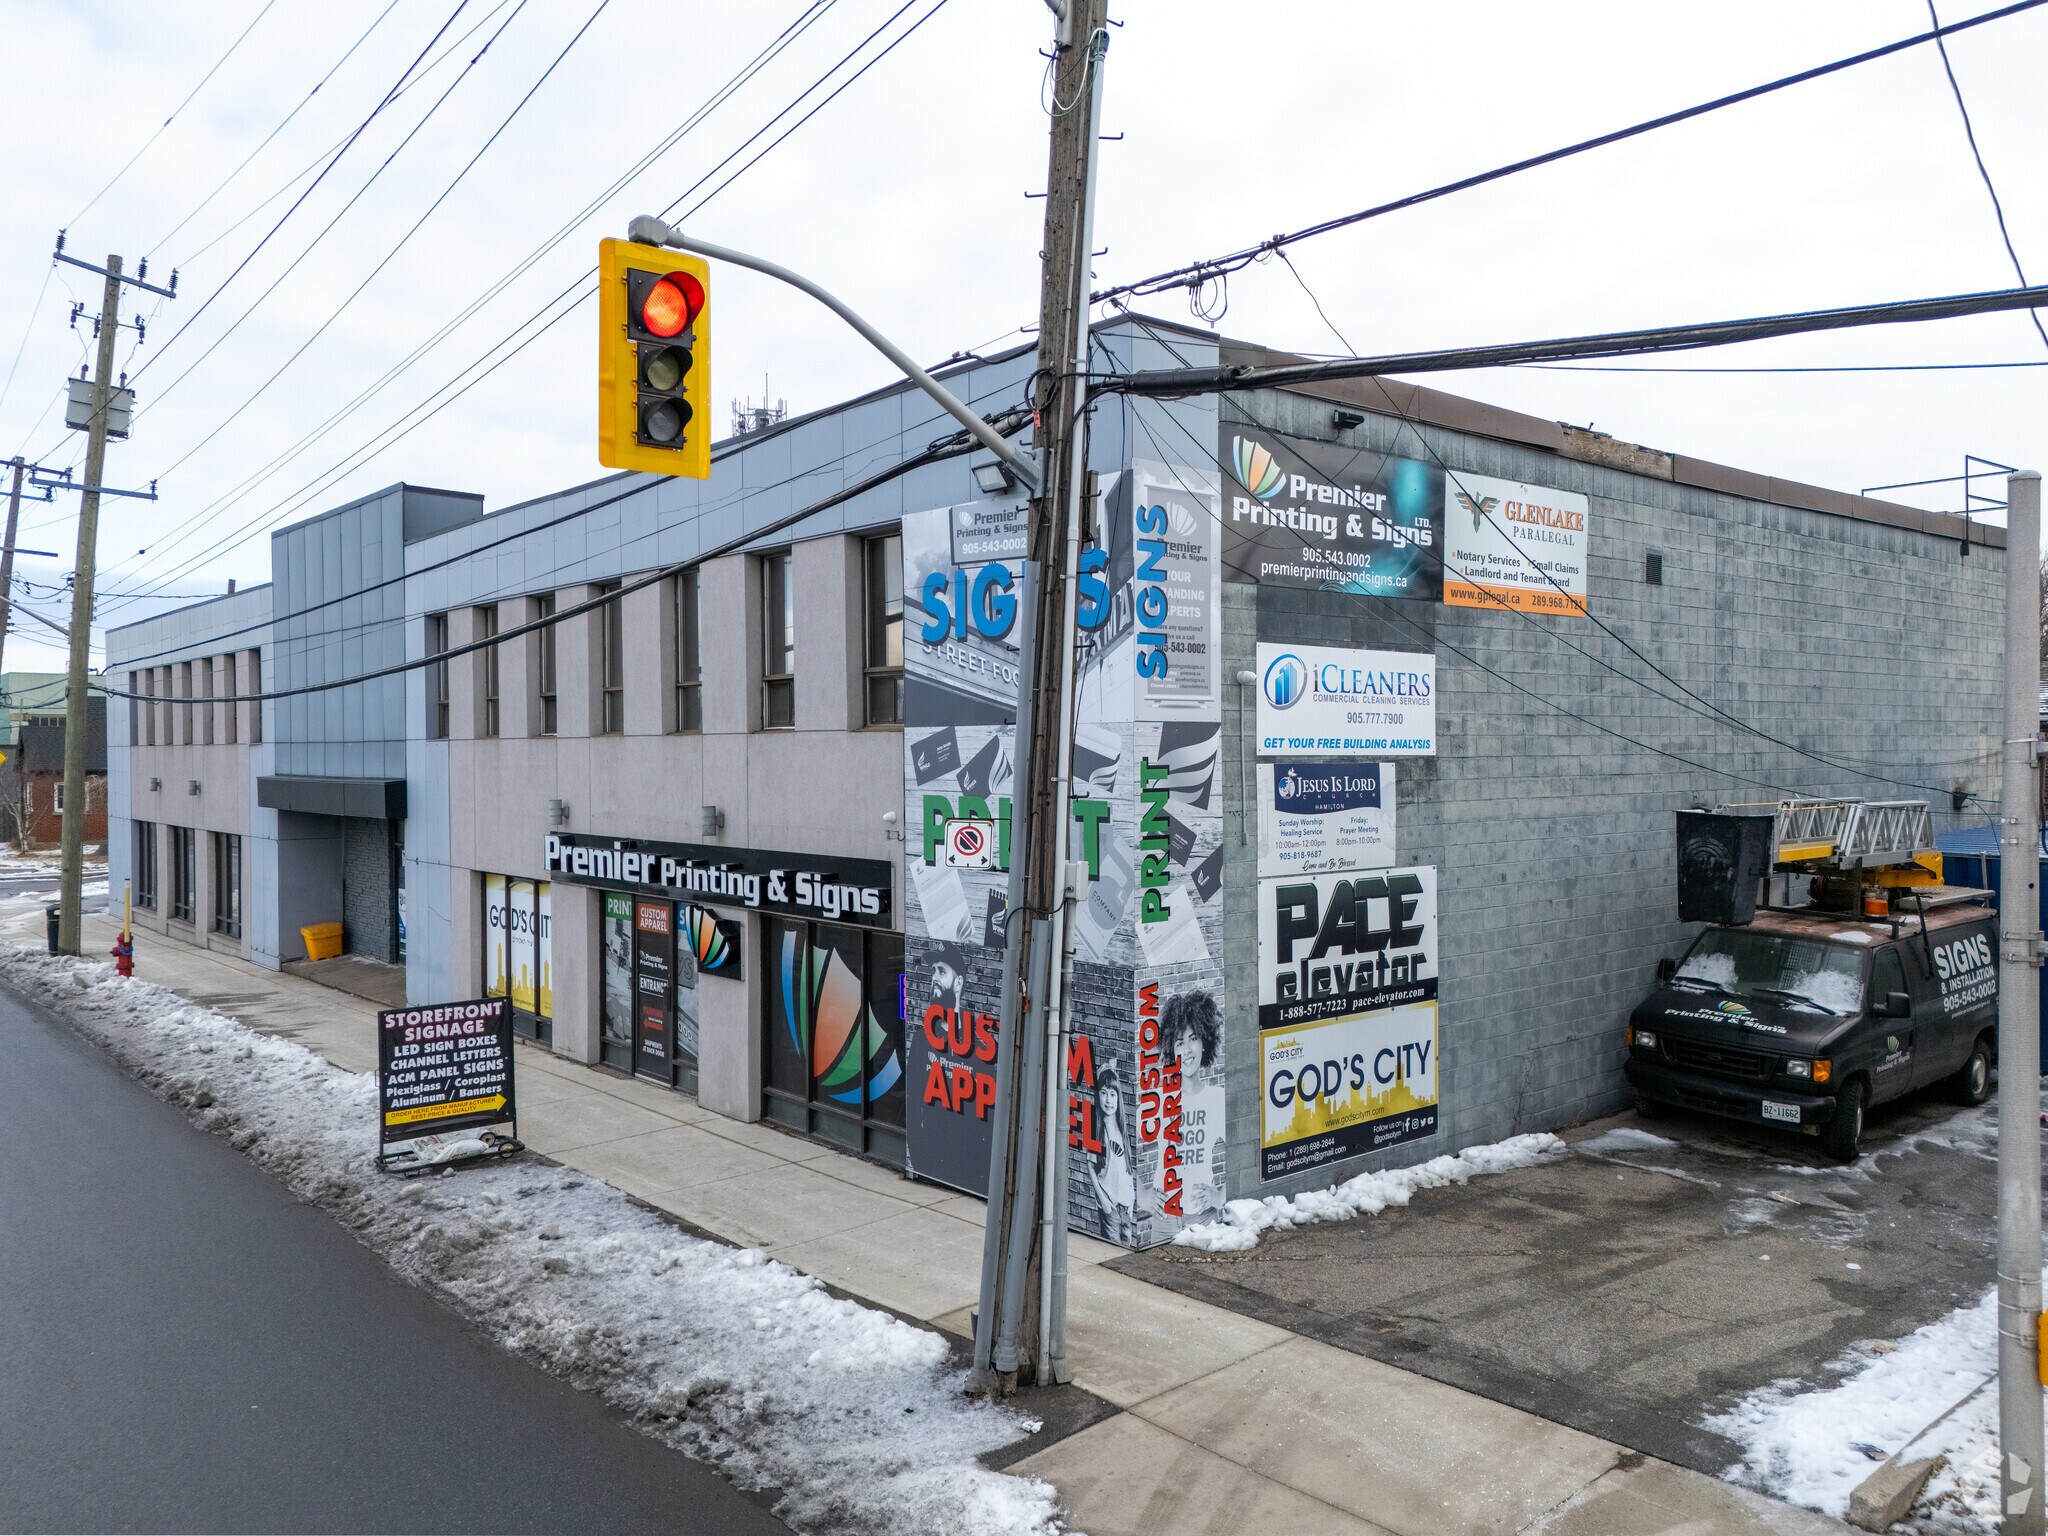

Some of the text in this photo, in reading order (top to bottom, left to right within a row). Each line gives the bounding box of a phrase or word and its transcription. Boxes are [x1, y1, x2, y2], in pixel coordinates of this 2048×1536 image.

[1290, 474, 1386, 511] Premier
[974, 510, 1020, 526] Premier
[1232, 496, 1432, 548] Printing & Signs
[1415, 517, 1432, 528] LTD.
[1504, 500, 1584, 531] GLENLAKE
[956, 521, 1028, 538] Printing & Signs
[1513, 526, 1574, 546] PARALEGAL
[1189, 553, 1208, 562] Signs
[1302, 547, 1371, 568] 905.543.0002
[1456, 550, 1520, 567] Notary Services
[1532, 560, 1579, 574] Small Claims
[1261, 561, 1408, 588] premierprintingandsigns.ca
[1464, 566, 1570, 588] Landlord and Tenant Board
[922, 548, 1112, 645] SIGS
[1136, 505, 1168, 681] SIGNS
[1450, 588, 1520, 605] www.gplegal.ca
[1312, 664, 1430, 697] iCLEANERS
[1312, 694, 1430, 706] COMMERCIAL CLEANING SERVICES
[1346, 712, 1404, 725] 905.777.7900
[1264, 738, 1431, 749] GET YOUR FREE BUILDING ANALYSIS
[1296, 776, 1376, 797] JESUS IS LORD
[1279, 818, 1324, 828] Sunday Worship:
[1340, 826, 1378, 836] Prayer Meeting
[1350, 816, 1368, 824] Friday:
[1140, 756, 1170, 924] PRINT
[1280, 830, 1302, 838] Healing
[544, 834, 656, 884] Premier
[660, 858, 760, 907] Printing
[768, 870, 788, 904] &
[795, 872, 881, 918] Signs
[608, 898, 632, 917] PRINT
[640, 907, 667, 922] CUSTOM
[1092, 890, 1117, 922] COMPANY
[640, 920, 668, 932] APPAREL
[1276, 874, 1424, 964] PACE
[646, 953, 663, 964] Premier
[1934, 934, 1991, 980] SIGNS
[1276, 950, 1427, 1005] elevator
[1941, 964, 1994, 994] & INSTALLATION
[1280, 987, 1424, 1020] 1-888-577-7223 pace-elevator.com
[1944, 980, 1996, 1012] 905-543-0002
[385, 1002, 502, 1028] STOREFRONT
[1664, 1008, 1724, 1022] Printing
[1744, 1020, 1788, 1034] Signs
[1698, 1008, 1758, 1022] Premier
[404, 1019, 484, 1042] SIGNAGE
[394, 1034, 498, 1058] LED SIGN BOXES
[1270, 1050, 1290, 1060] GOD'S
[1290, 1047, 1304, 1056] CITY
[390, 1046, 501, 1070] CHANNEL LETTERS
[1139, 982, 1159, 1143] CUSTOM
[388, 1058, 504, 1086] ACM PANEL SIGNS
[1270, 1040, 1432, 1109] GOD'S CITY
[386, 1072, 506, 1098] Plexiglass / Coroplast
[391, 1084, 502, 1108] Aluminum / Banners
[391, 1110, 412, 1118] ORDER
[414, 1107, 430, 1115] HERE
[449, 1098, 496, 1108] MANUFACTURER
[452, 1106, 476, 1114] QUALITY
[1325, 1106, 1384, 1128] www.godscitym.com
[1162, 1054, 1184, 1218] APPAREL
[1374, 1124, 1388, 1132] Follow
[1268, 1152, 1288, 1162] Phone:
[1289, 1148, 1292, 1156] 1
[1268, 1146, 1346, 1174] Email: godscitym@gmail.com
